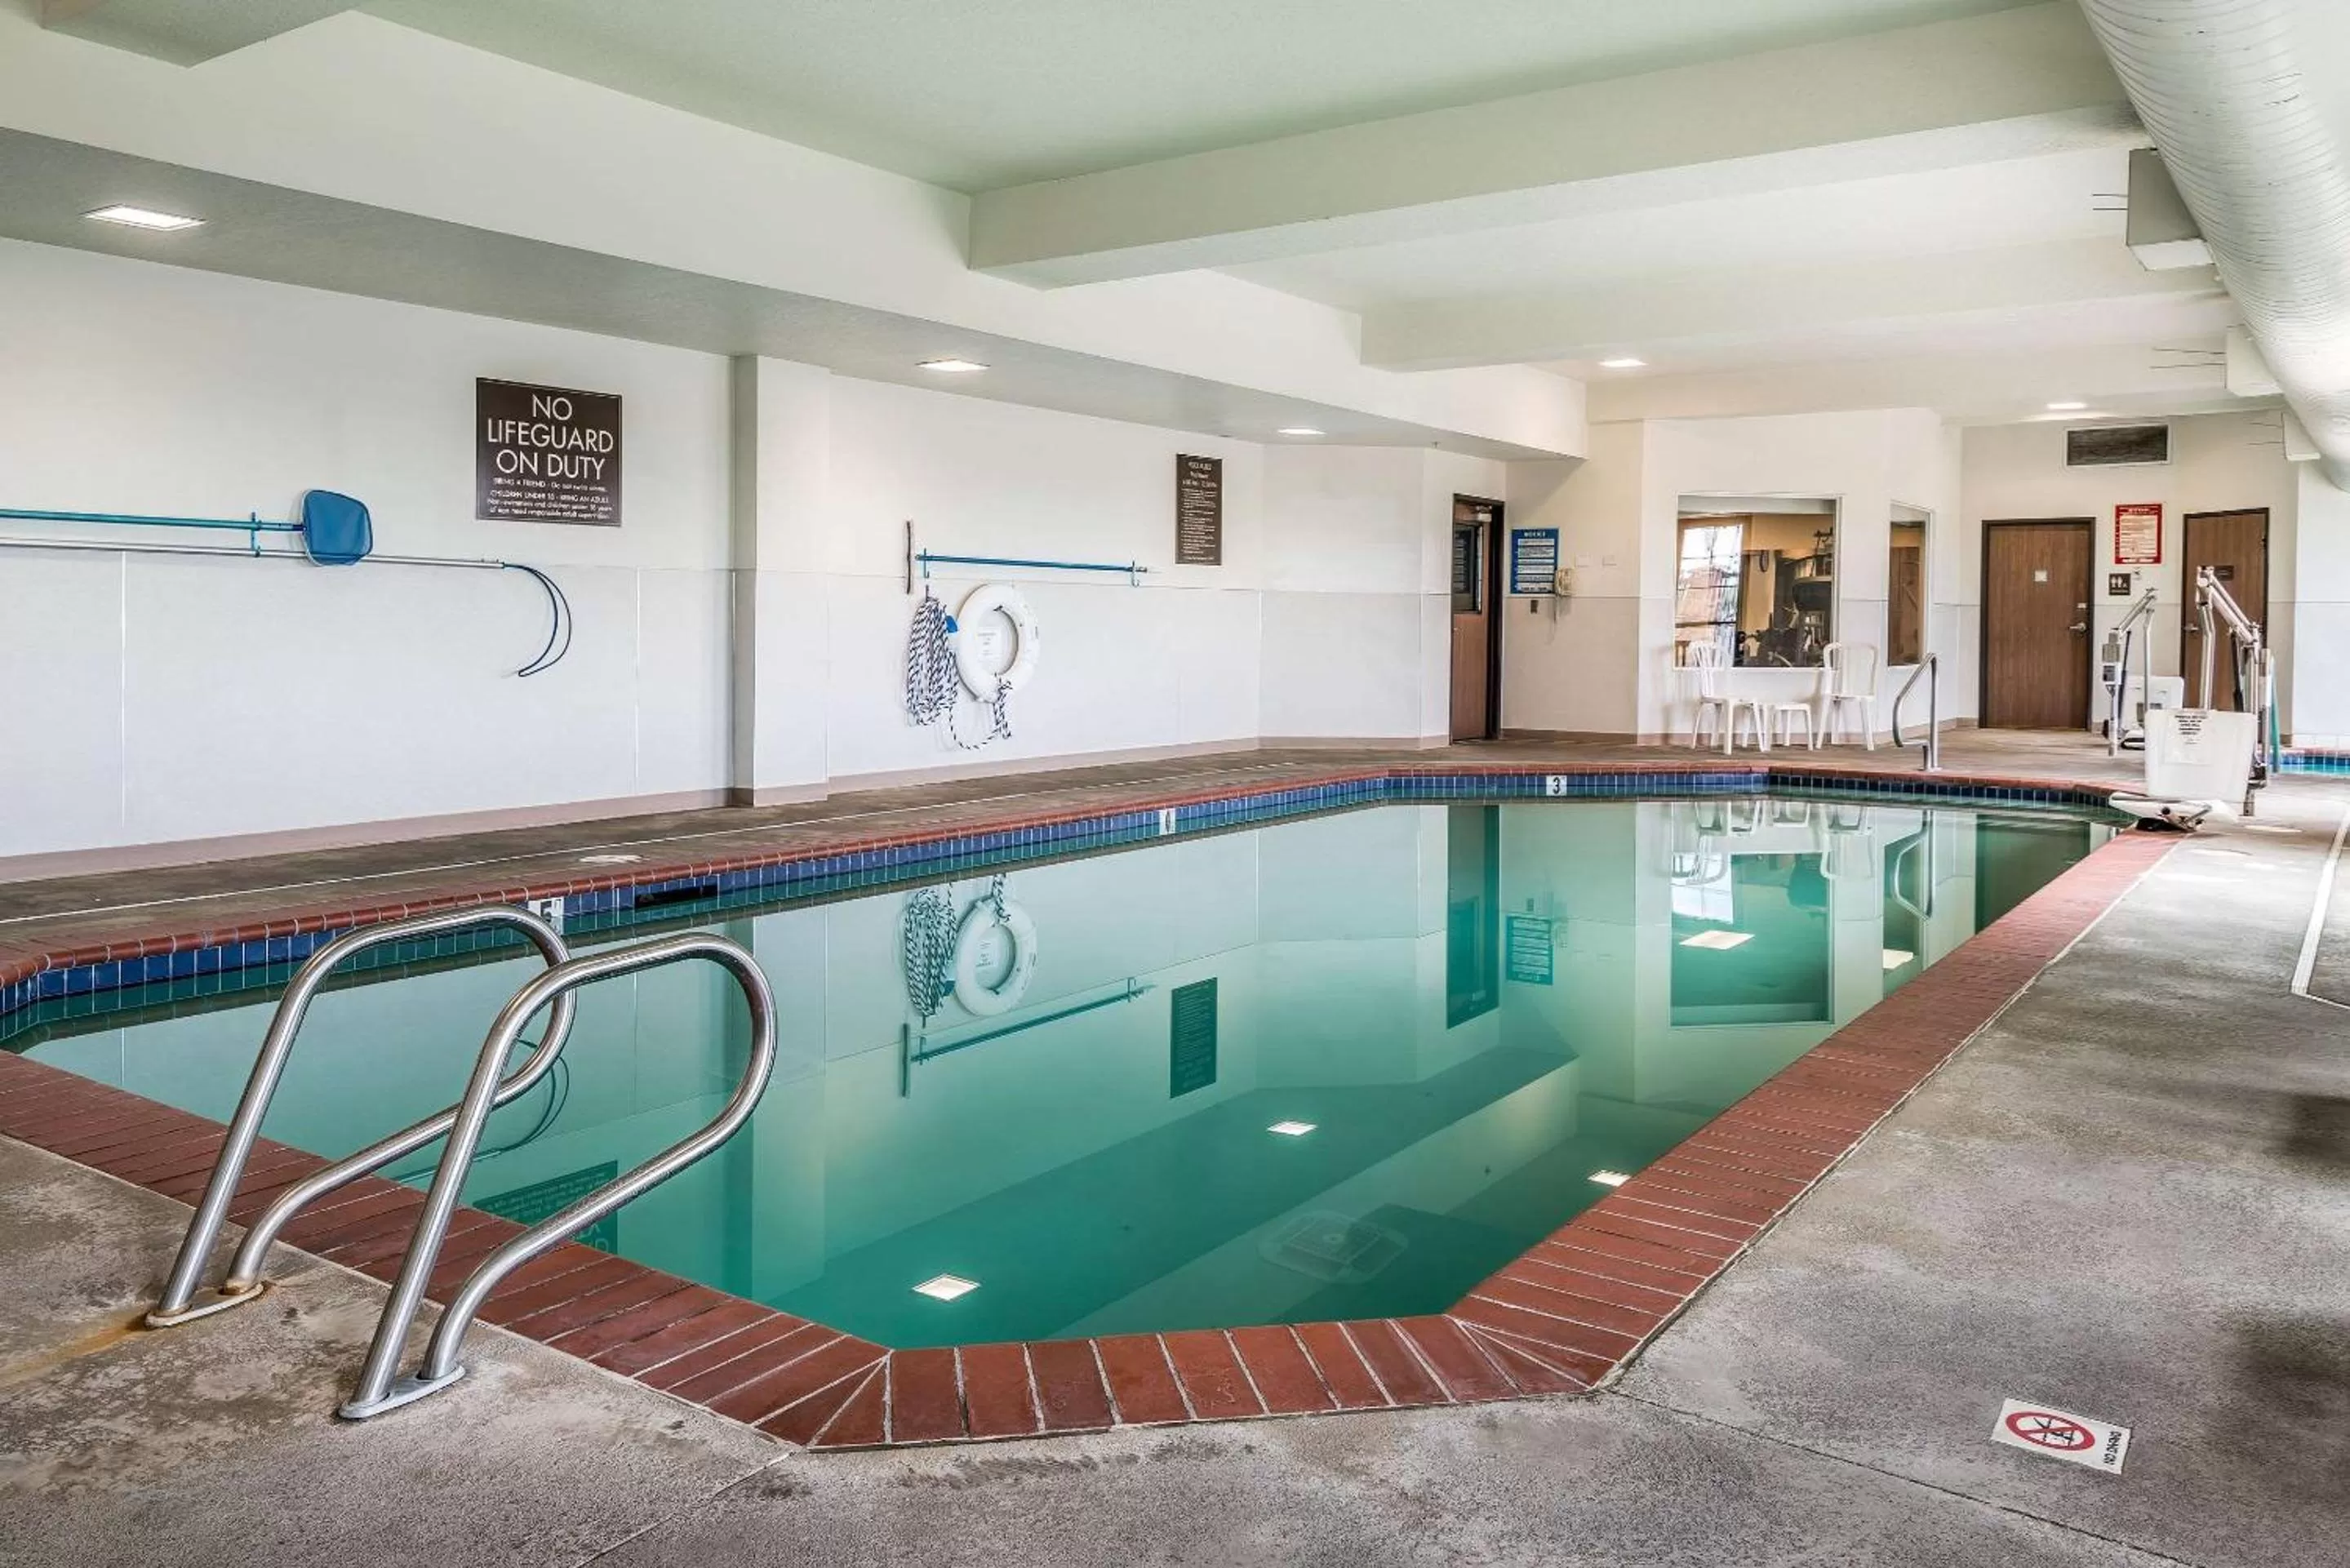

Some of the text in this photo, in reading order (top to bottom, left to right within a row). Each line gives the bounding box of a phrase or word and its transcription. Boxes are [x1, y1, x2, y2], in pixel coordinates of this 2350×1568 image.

[532, 393, 573, 421] NO
[487, 417, 614, 453] LIFEGUARD
[496, 449, 606, 480] ON DUTY
